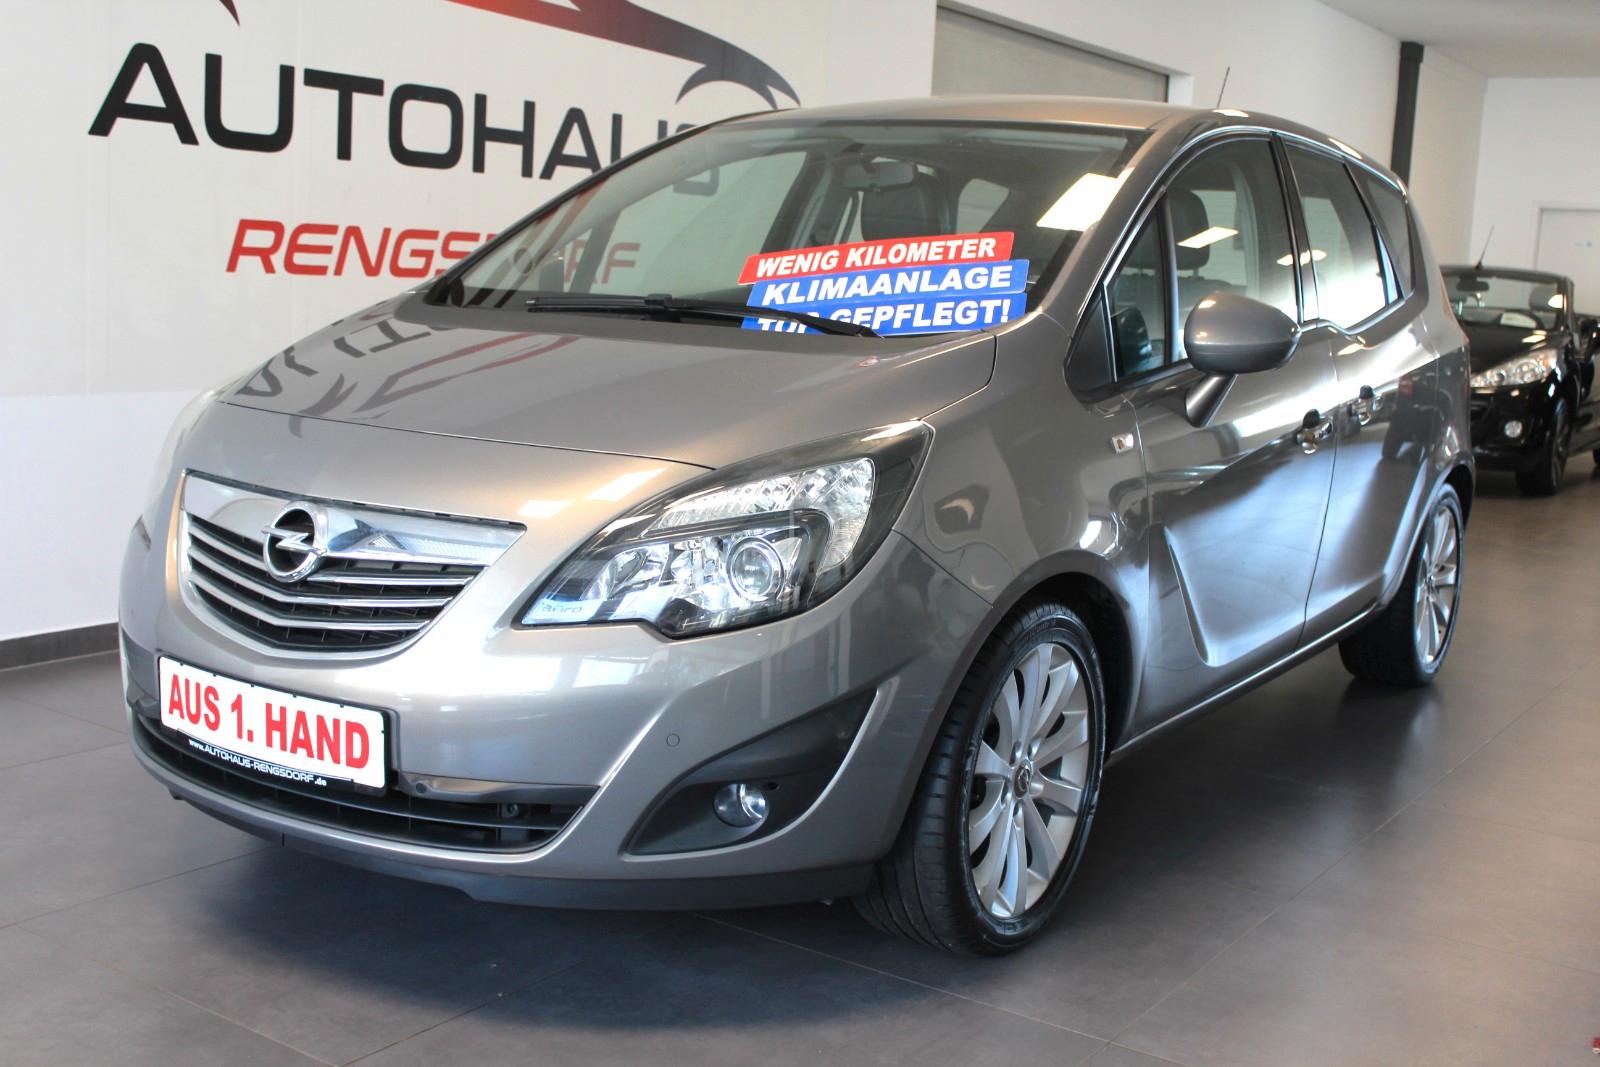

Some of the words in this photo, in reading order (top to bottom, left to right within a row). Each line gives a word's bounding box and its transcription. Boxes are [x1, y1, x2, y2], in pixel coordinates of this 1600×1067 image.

[756, 251, 839, 278] WENIG
[845, 237, 996, 268] KILOMETER
[761, 265, 1013, 306] KLIMAANLAGE
[168, 673, 221, 731] AUS
[231, 693, 254, 743] 1.
[265, 702, 370, 769] HAND
